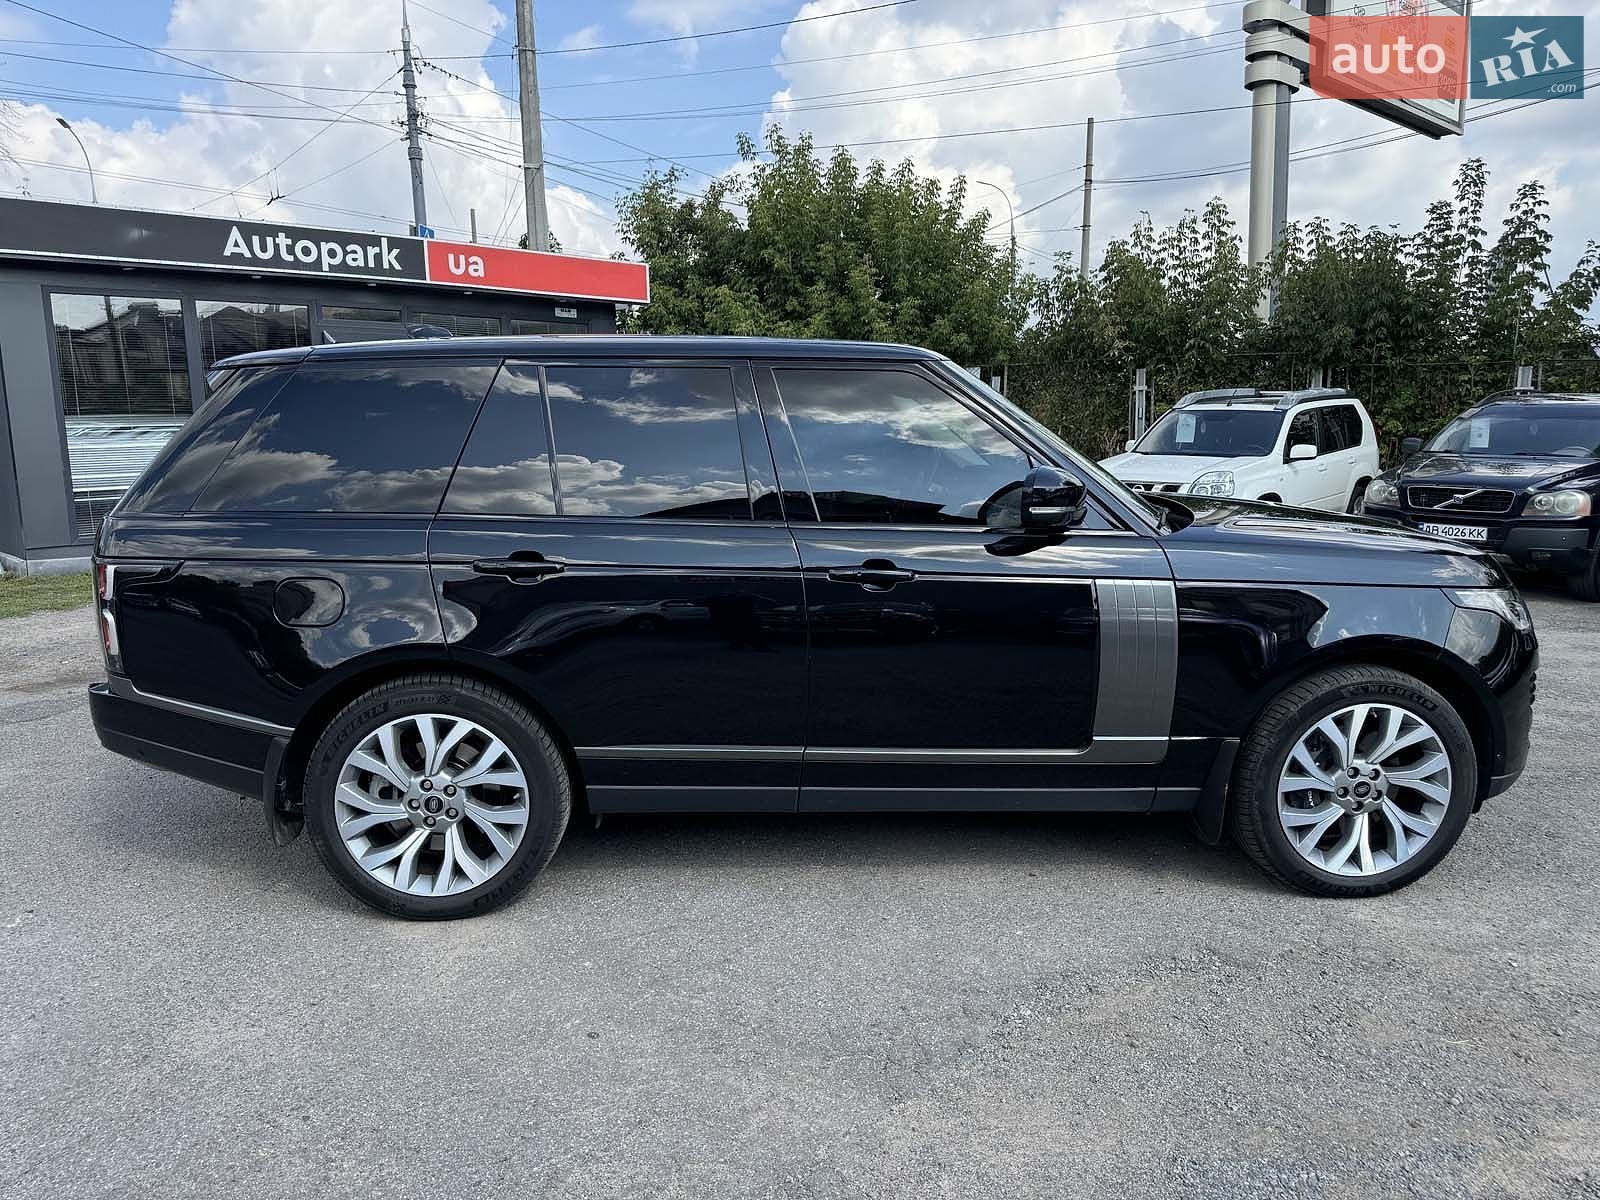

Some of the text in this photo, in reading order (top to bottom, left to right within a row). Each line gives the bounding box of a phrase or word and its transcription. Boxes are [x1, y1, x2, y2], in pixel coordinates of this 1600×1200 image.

[223, 225, 485, 278] Autopark ua
[1441, 526, 1467, 537] 4026
